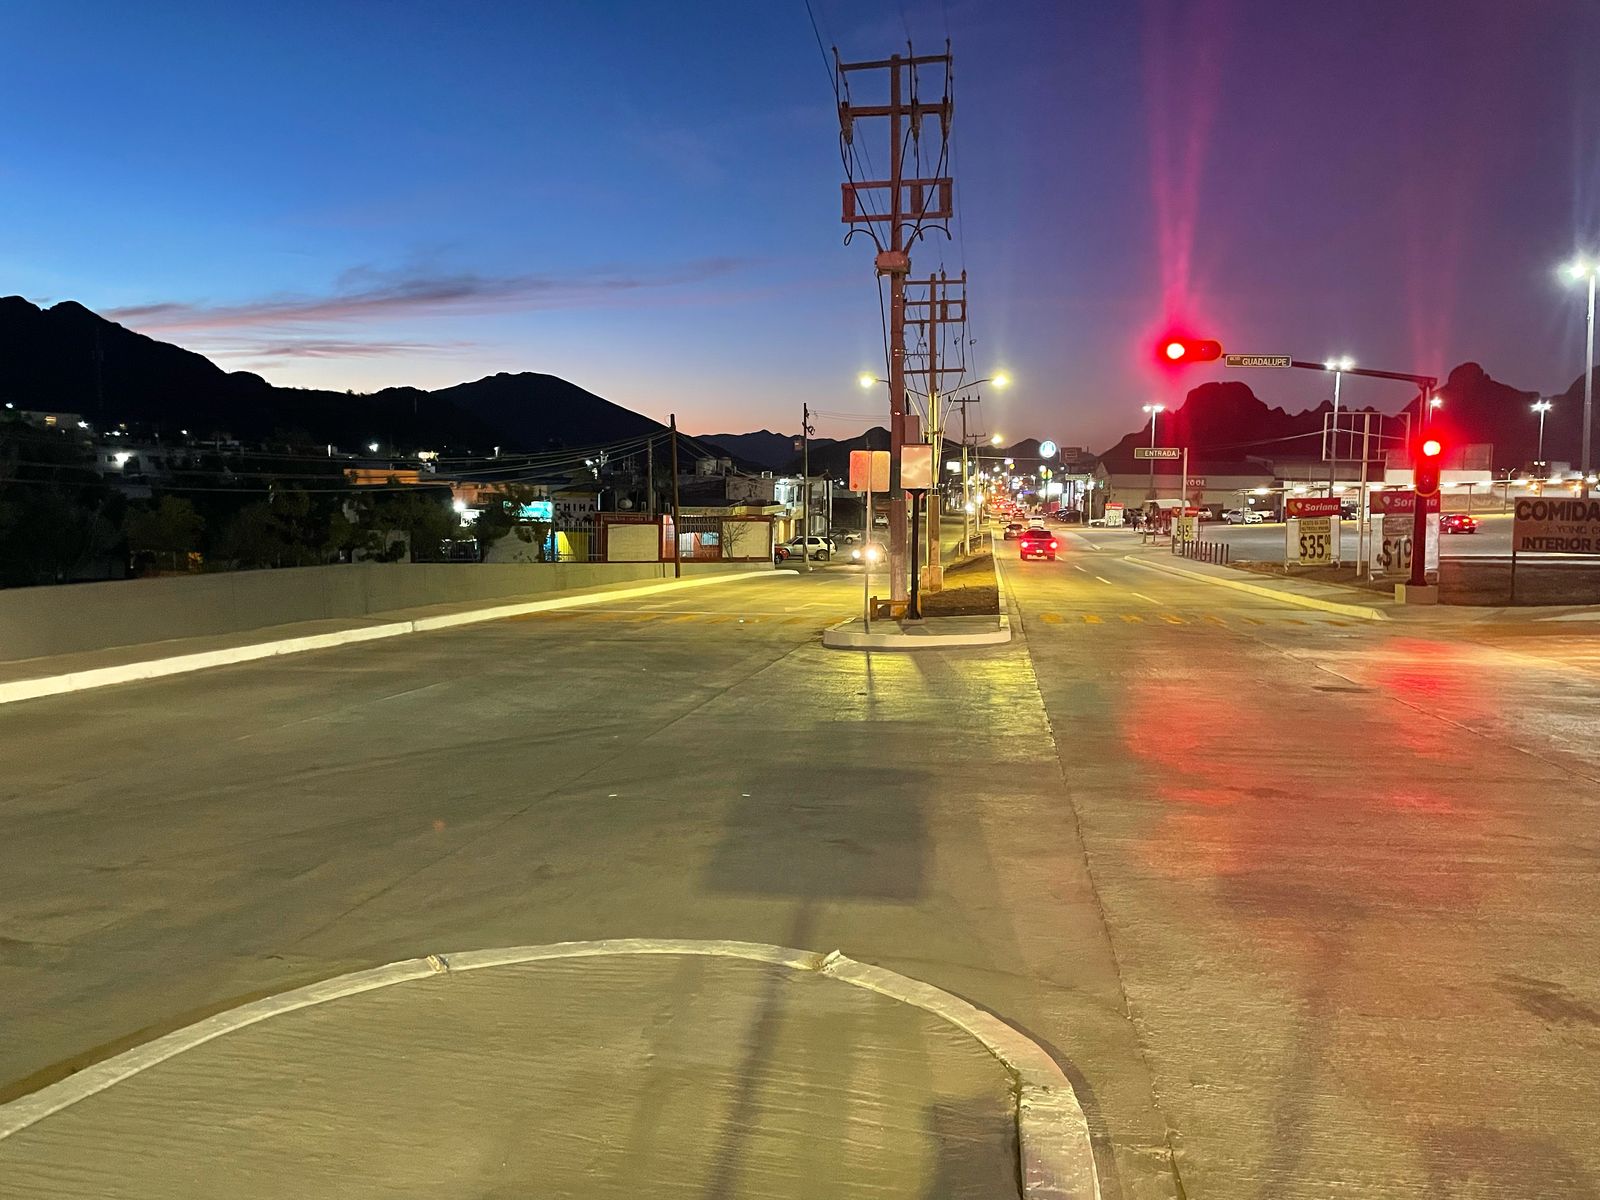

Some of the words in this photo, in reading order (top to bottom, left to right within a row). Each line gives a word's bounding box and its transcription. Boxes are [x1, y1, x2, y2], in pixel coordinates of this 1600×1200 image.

[1242, 358, 1287, 366] GUADALUPE
[1304, 502, 1339, 512] Soriana
[1394, 498, 1438, 507] Sora
[1300, 534, 1324, 560] $35
[1522, 536, 1591, 551] INTERIOR
